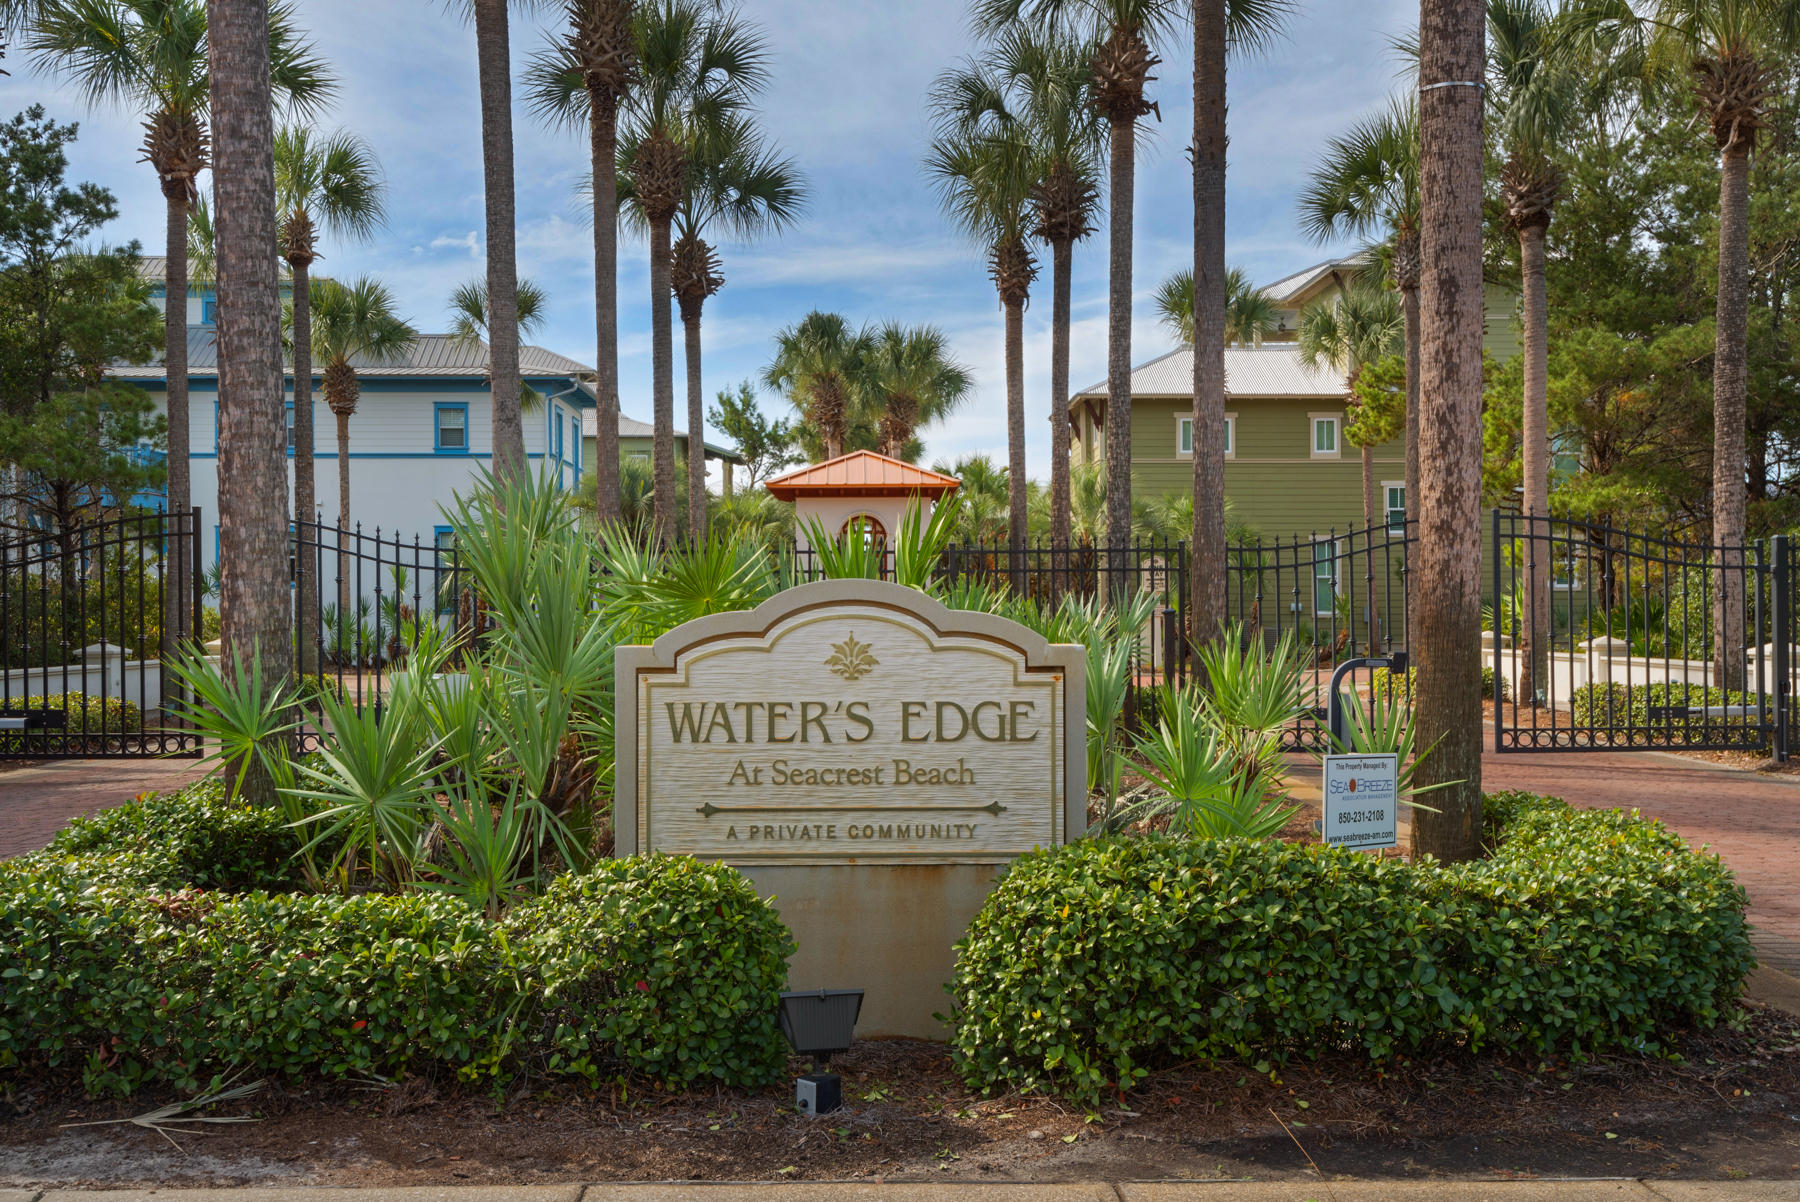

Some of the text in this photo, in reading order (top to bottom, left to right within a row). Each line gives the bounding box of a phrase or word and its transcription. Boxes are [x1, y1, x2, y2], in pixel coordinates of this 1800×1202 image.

[664, 701, 1039, 743] WATER'S EDGE
[727, 757, 976, 785] At Seacrest Beach
[1345, 763, 1362, 771] Property
[1363, 762, 1380, 770] Managed
[1330, 778, 1393, 794] SEA BREEZE
[1338, 809, 1385, 824] 850-231-2108
[727, 823, 978, 839] A PRIVATE COMMUNITY
[1328, 831, 1394, 843] www.seabreeze-am.com
